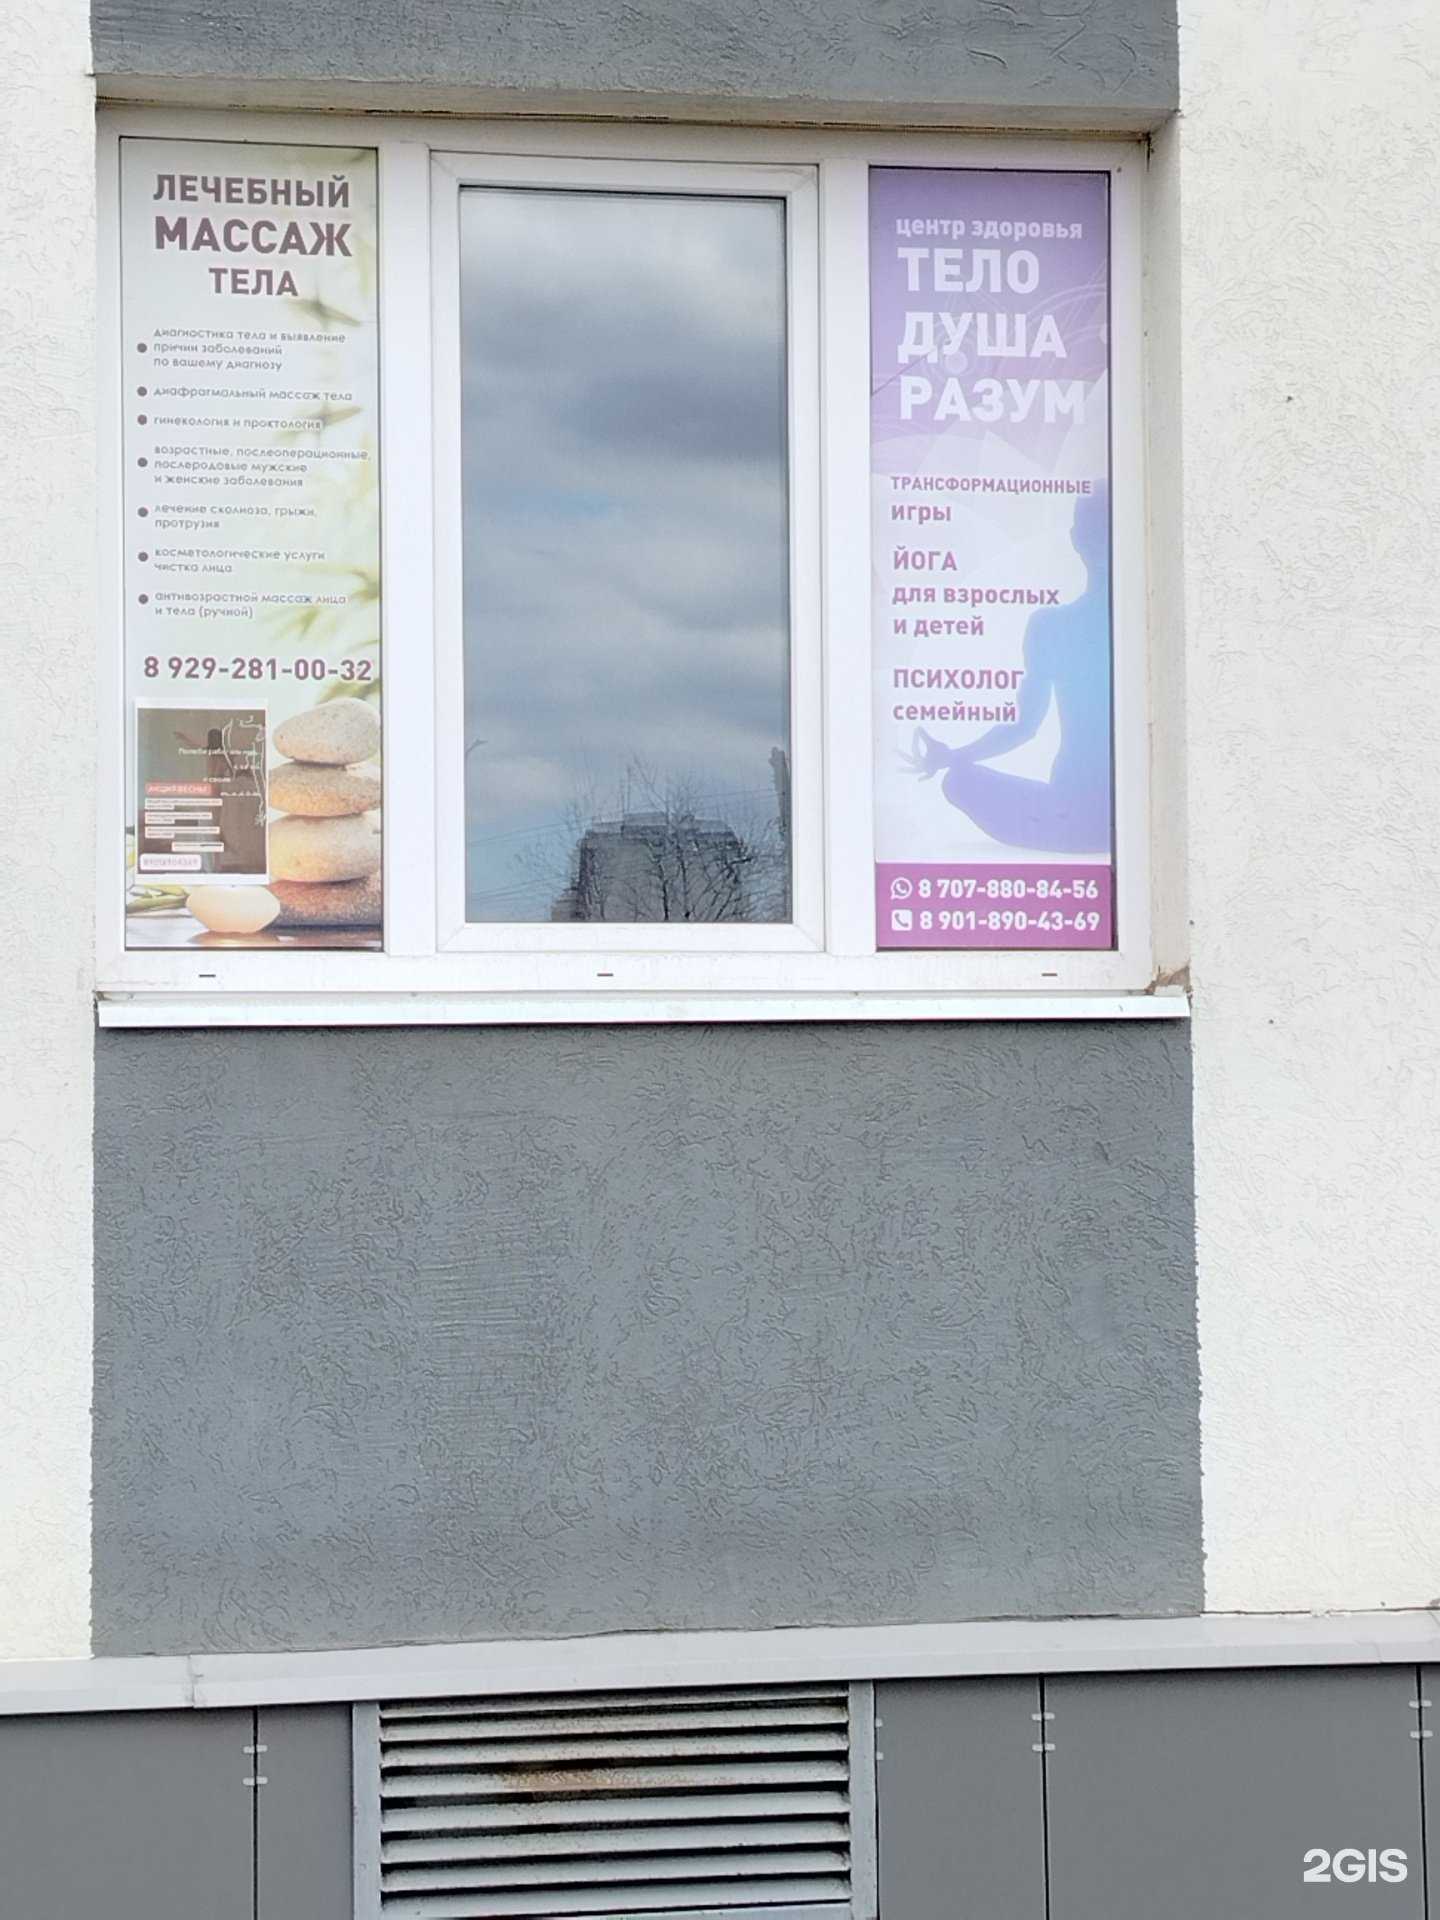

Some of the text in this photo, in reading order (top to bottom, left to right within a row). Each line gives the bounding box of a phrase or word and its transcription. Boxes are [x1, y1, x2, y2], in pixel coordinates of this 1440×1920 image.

[153, 174, 350, 208] ЛЕЧЕБНЫЙ
[154, 216, 352, 257] МАССАЖ
[896, 218, 1083, 242] центр здоровья
[897, 247, 1040, 294] ТЕЛО
[208, 267, 299, 297] ТЕЛА
[153, 328, 346, 344] диагностика тела и выявление
[897, 311, 1068, 364] ДУША
[153, 343, 283, 355] причин заболеваний
[153, 358, 283, 372] по вашему диагнозу
[153, 386, 352, 401] диафрагмальный массаж тела
[899, 375, 1086, 425] РАЗУМ
[153, 416, 321, 430] гинекология и проктология
[154, 461, 308, 474] послеродовые мужские
[154, 476, 304, 487] и женские заболевания
[891, 476, 1092, 495] ТРАНСФОРМАЦИОННЫЕ
[154, 504, 207, 514] лечение
[891, 504, 952, 525] игры
[154, 548, 326, 562] косметологические услуги
[893, 545, 958, 571] ЙОГА
[154, 562, 232, 573] чистка лица
[154, 592, 346, 605] антивозрастной массаж лица
[892, 587, 1060, 608] для взрослых
[154, 606, 253, 619] и тела (ручной)
[893, 616, 985, 638] и детей
[144, 656, 372, 681] 8 929-281-00-32
[893, 668, 1024, 690] ПСИХОЛОГ
[893, 701, 1017, 723] семейный
[918, 879, 1098, 899] 8 707-880-84-56
[920, 911, 1100, 931] 8 901-890-43-69
